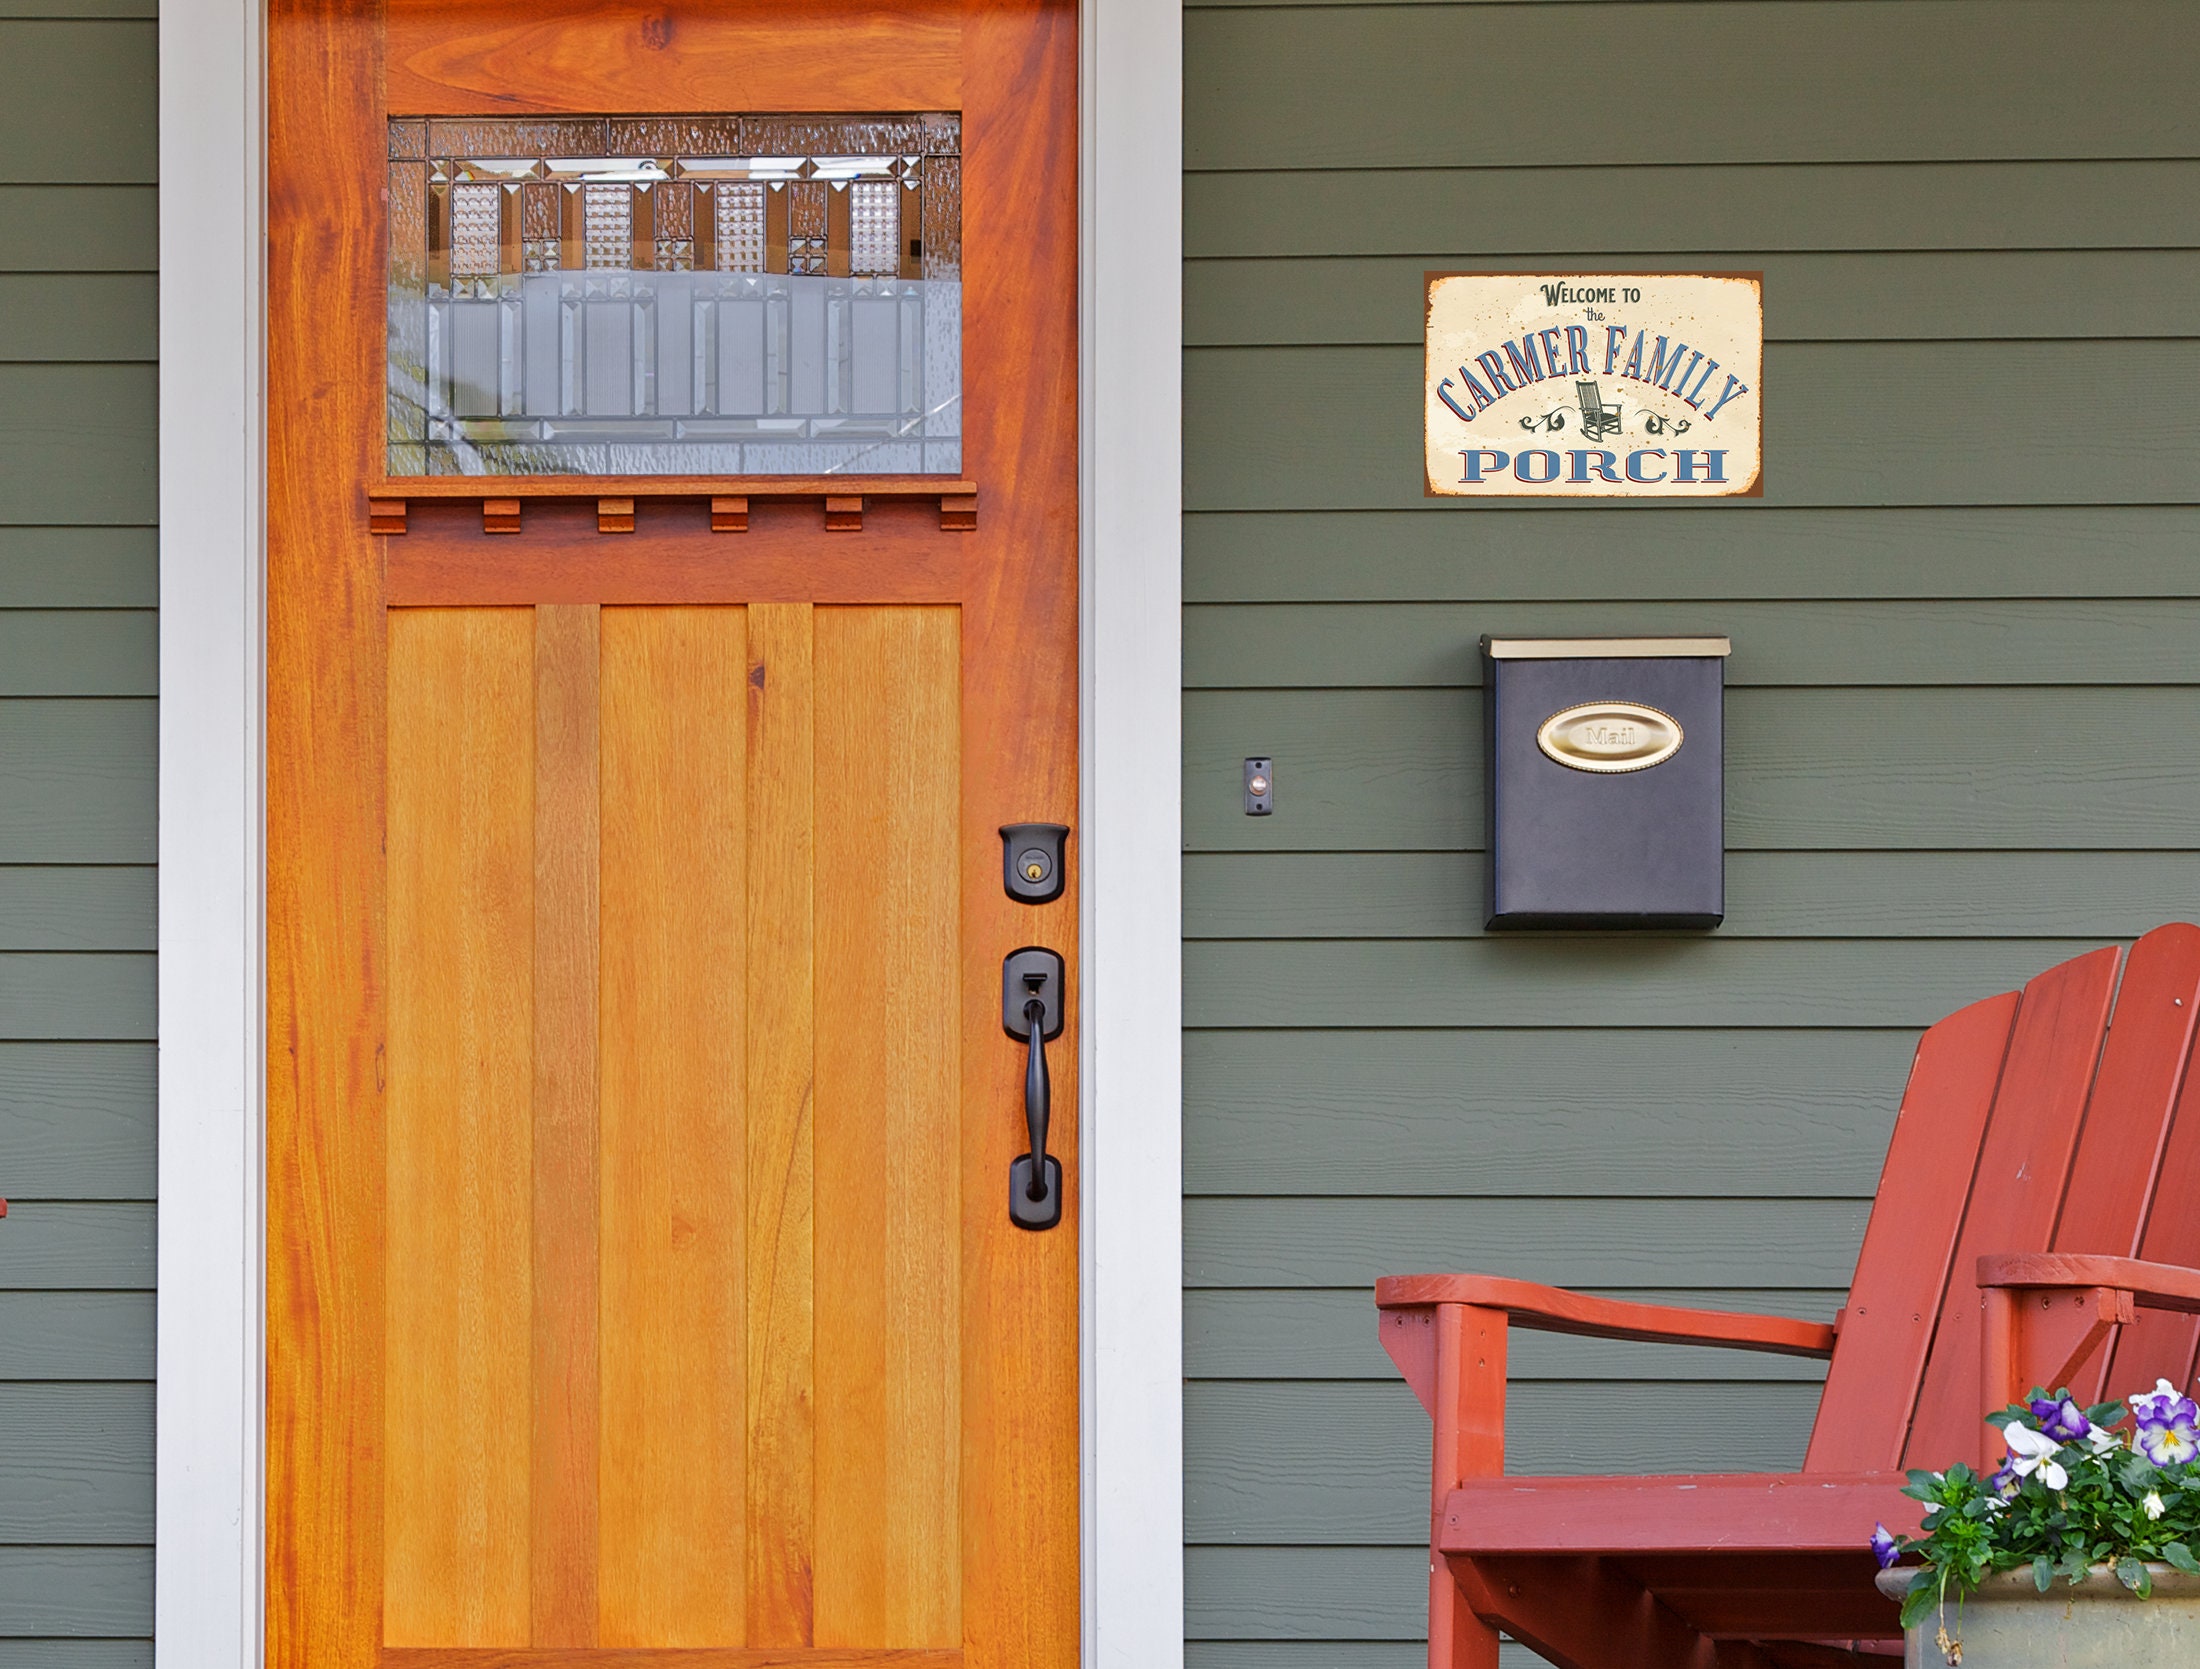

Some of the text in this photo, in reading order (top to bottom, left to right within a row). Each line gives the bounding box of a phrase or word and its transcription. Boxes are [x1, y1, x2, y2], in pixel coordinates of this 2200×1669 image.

[1540, 281, 1641, 306] WELCOME TO
[1586, 307, 1606, 322] the
[1436, 324, 1749, 423] CARMER FAMILY
[1457, 448, 1730, 484] PORCH
[1586, 727, 1636, 745] Mail
